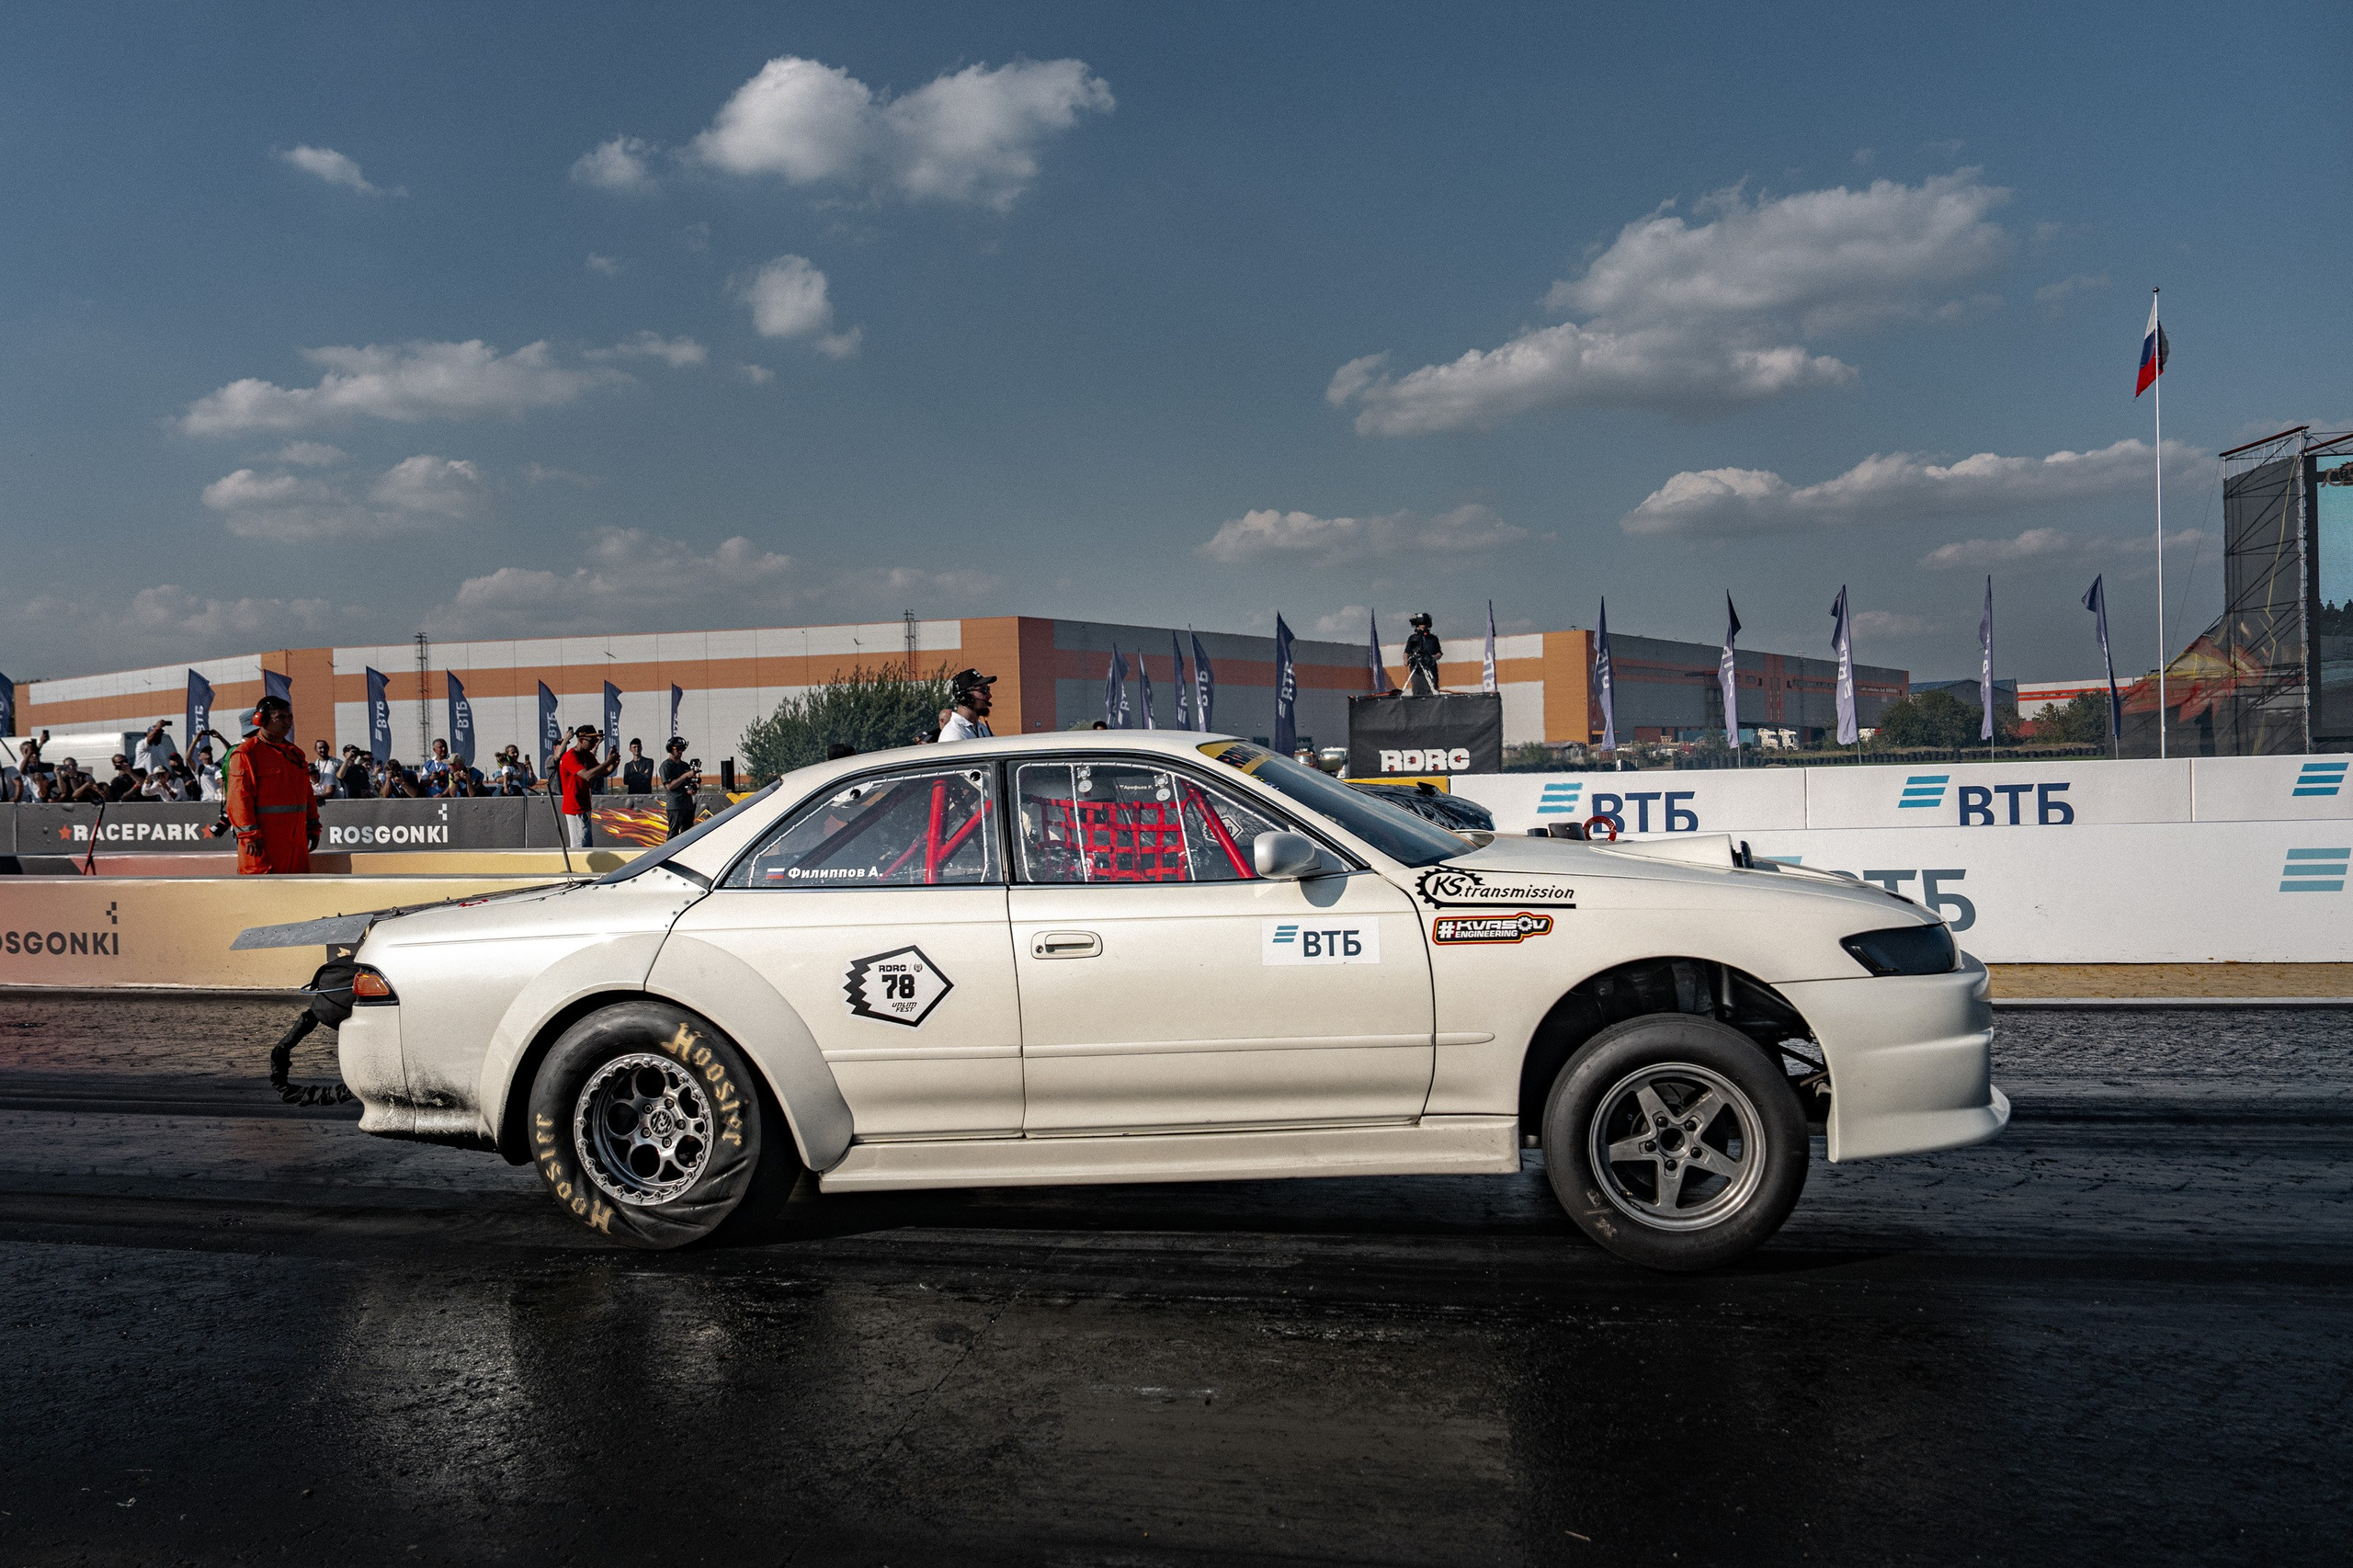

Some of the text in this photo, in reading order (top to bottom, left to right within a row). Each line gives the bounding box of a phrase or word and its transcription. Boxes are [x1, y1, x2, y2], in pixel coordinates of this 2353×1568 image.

[376, 700, 388, 729] ВТБ
[456, 701, 469, 728] ВТБ
[546, 711, 558, 738] ВТБ
[1379, 747, 1470, 772] RDRC
[1592, 791, 1699, 833] ВТБ
[1958, 783, 2075, 825] ВТБ
[73, 824, 199, 842] RACEPARK
[329, 825, 449, 844] ROSGONKI
[788, 866, 883, 879] Филиппов А.
[1829, 869, 1976, 932] ТБ
[0, 931, 119, 955] SGONKI
[1303, 930, 1362, 957] ВТБ
[1455, 929, 1518, 938] ENGINEERING
[879, 964, 907, 972] RDRC
[881, 974, 915, 999] 78
[661, 1022, 743, 1146] Hoosier
[536, 1113, 616, 1234] Hoosier
